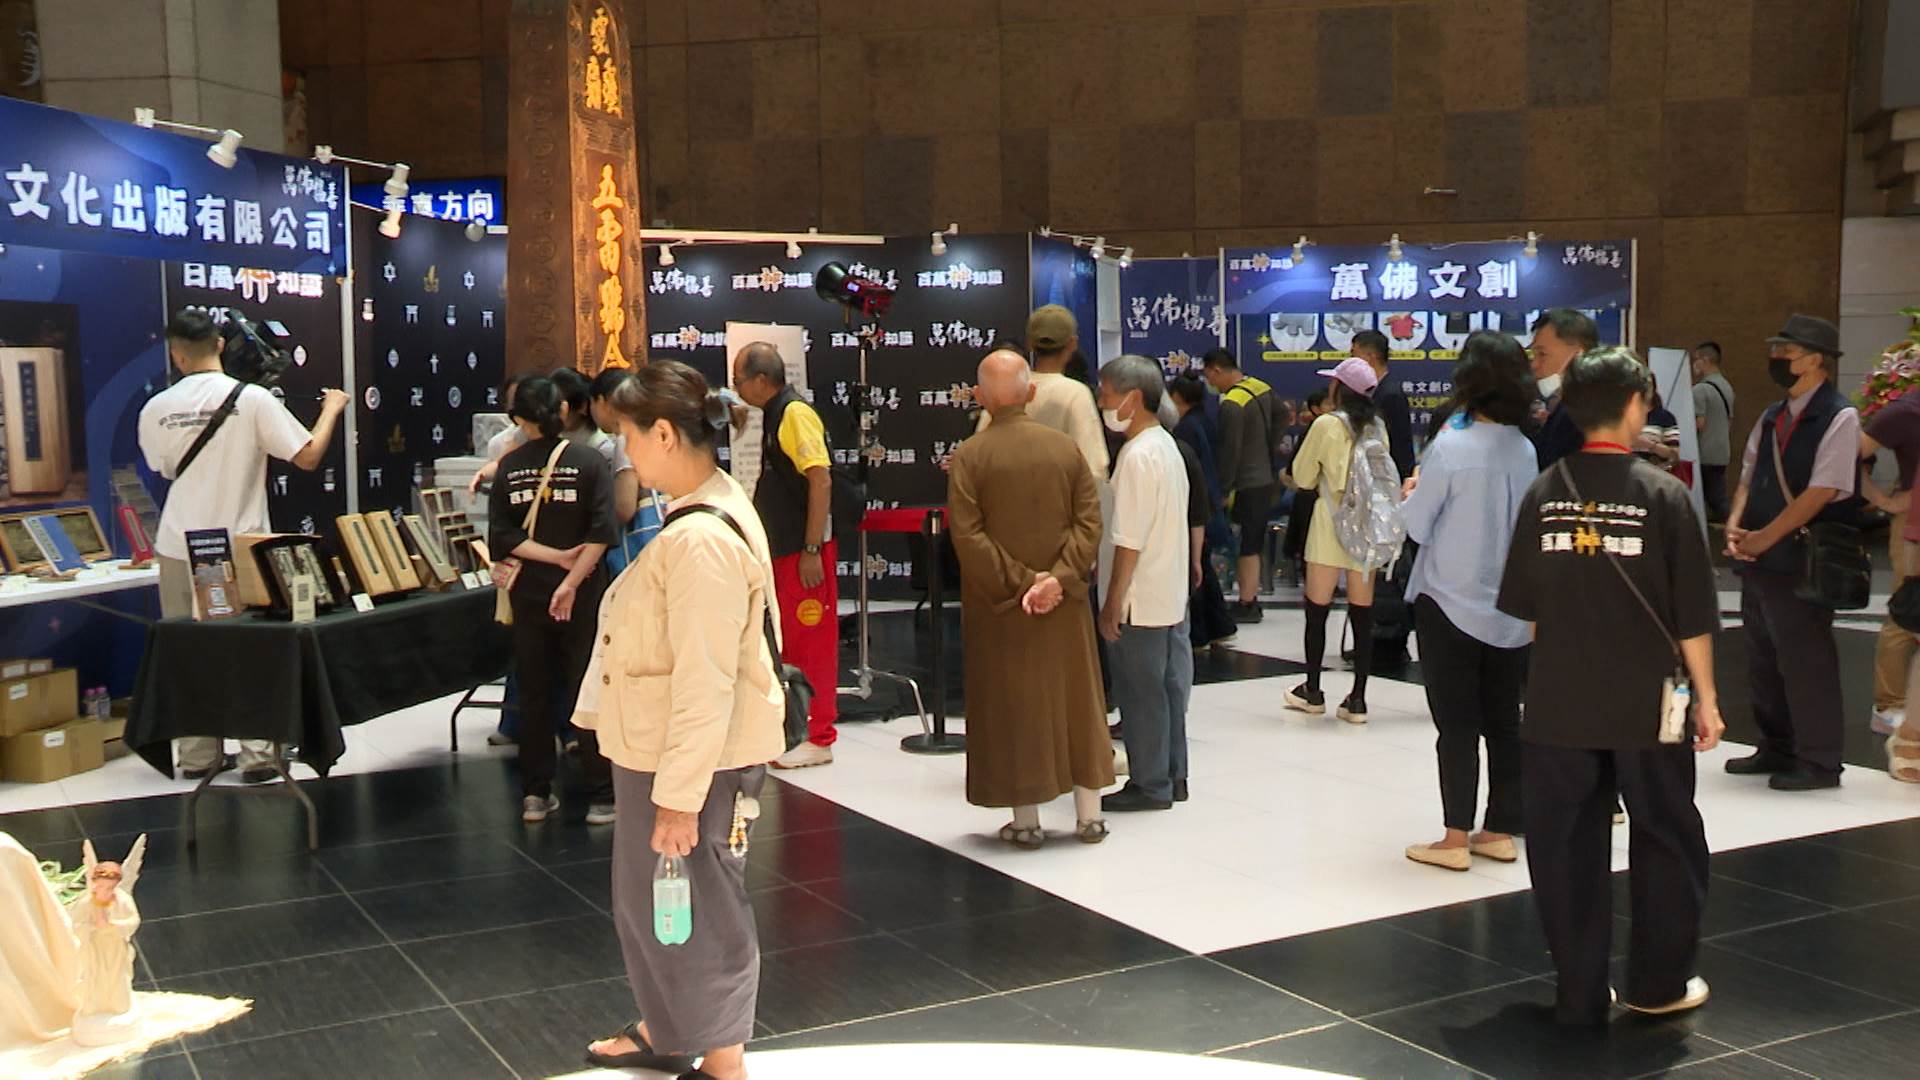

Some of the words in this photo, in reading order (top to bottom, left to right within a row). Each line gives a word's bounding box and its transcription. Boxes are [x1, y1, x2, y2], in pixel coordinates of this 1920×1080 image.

[5, 163, 331, 254] 文化出版有限公司
[1331, 259, 1517, 300] 萬佛文創
